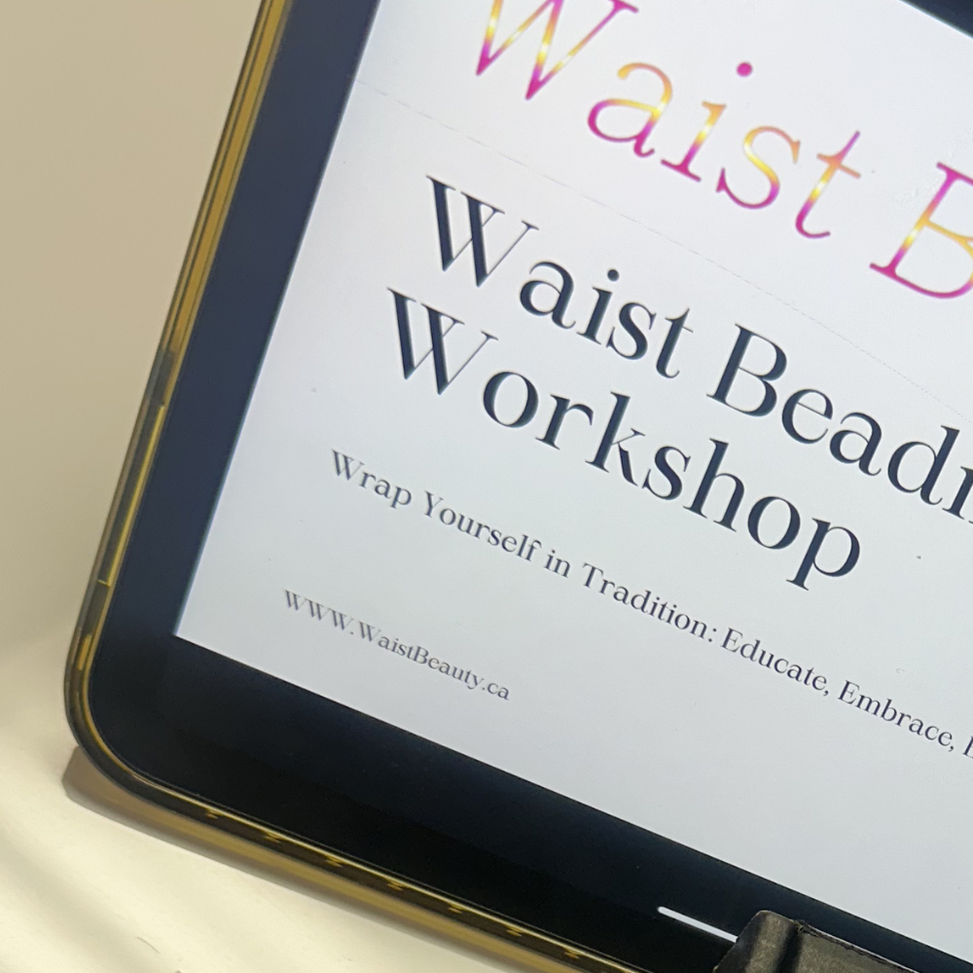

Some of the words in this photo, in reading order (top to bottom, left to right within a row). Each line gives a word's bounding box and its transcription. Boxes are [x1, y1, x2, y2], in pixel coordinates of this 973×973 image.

[475, 0, 862, 240] Waist
[426, 176, 694, 380] Waist
[386, 289, 862, 591] Workshop
[284, 589, 511, 701] WWW.WaistBeauty.ca
[331, 449, 412, 508] Wrap
[424, 491, 541, 564] Yourself
[543, 549, 571, 578] in
[581, 562, 719, 645] Tradition:
[720, 630, 832, 698] Educate,
[838, 680, 957, 753] Embrace,
